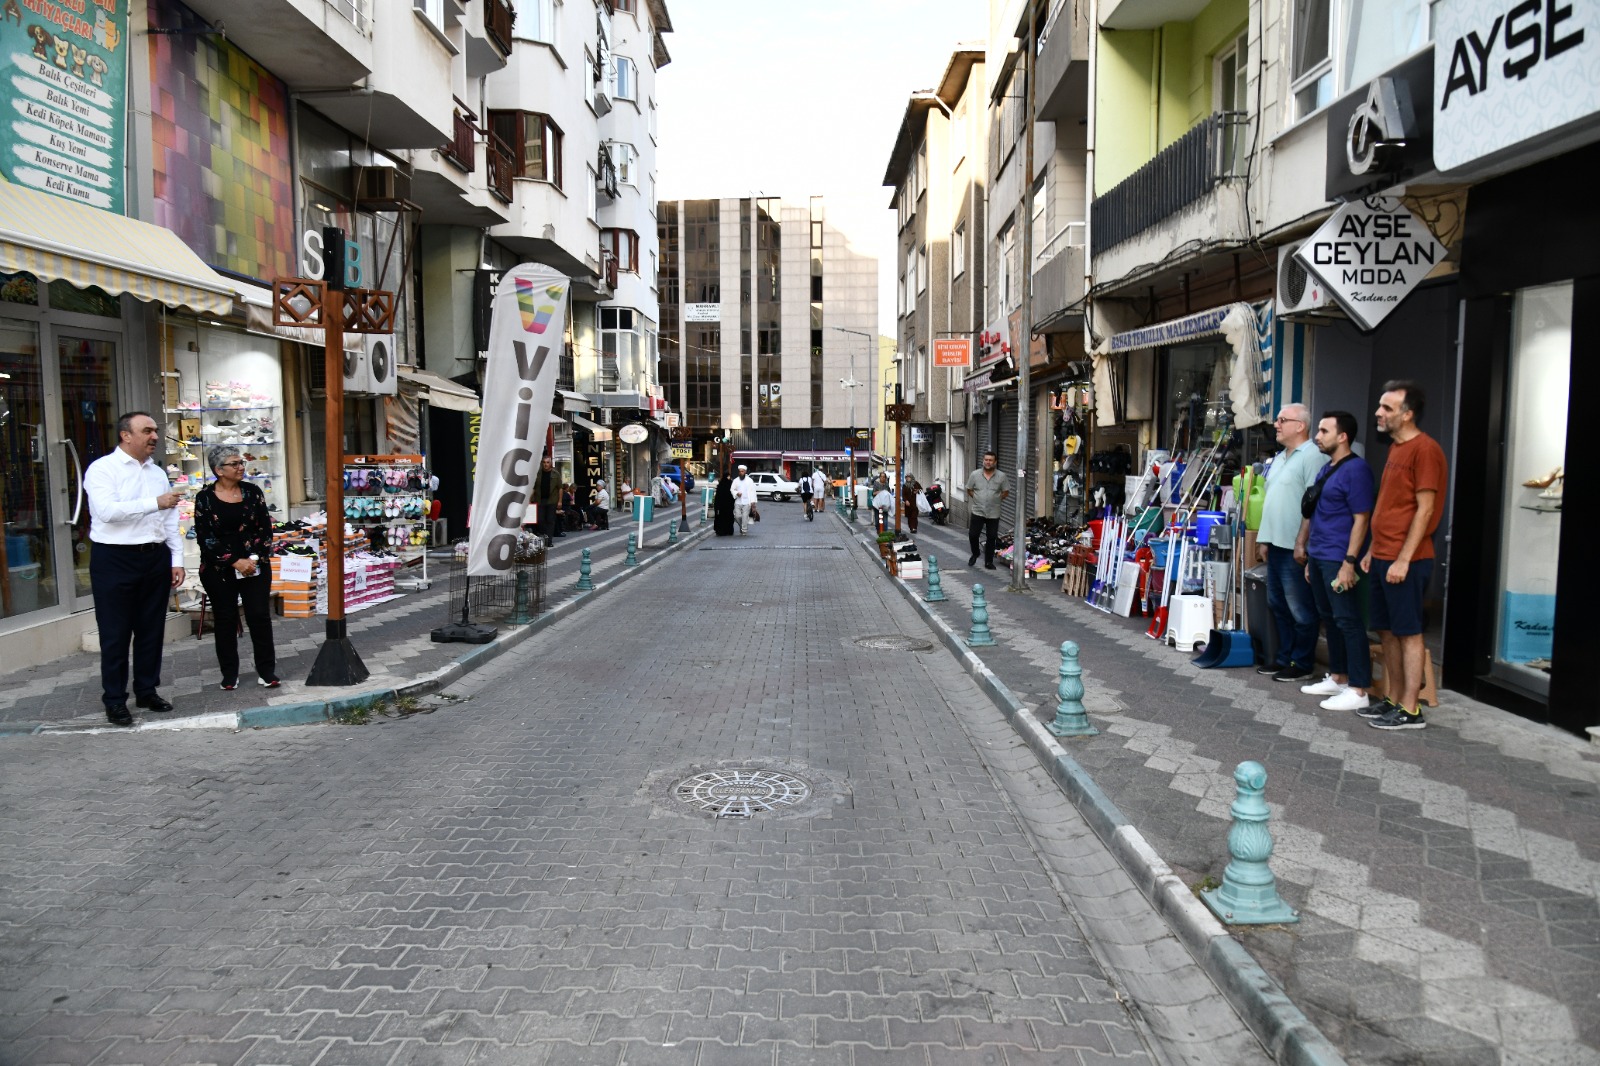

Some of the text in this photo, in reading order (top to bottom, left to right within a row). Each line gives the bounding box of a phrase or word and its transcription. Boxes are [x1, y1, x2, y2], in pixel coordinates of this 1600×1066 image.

[1441, 0, 1584, 111] AYŞE
[39, 63, 97, 98] Balık Çeşitleri
[46, 88, 90, 117] Balık Yemi
[26, 102, 106, 144] Kedi Köpek Maması
[49, 134, 87, 157] Kuş Yemi
[35, 150, 99, 182] Konserve Mama
[45, 176, 90, 200] Kedi Kumu
[1338, 214, 1411, 240] AYŞE
[1314, 242, 1434, 264] CEYLAN
[1343, 269, 1406, 284] MODA
[1112, 334, 1132, 349] BAHAR
[1514, 620, 1553, 631] Kadın.
